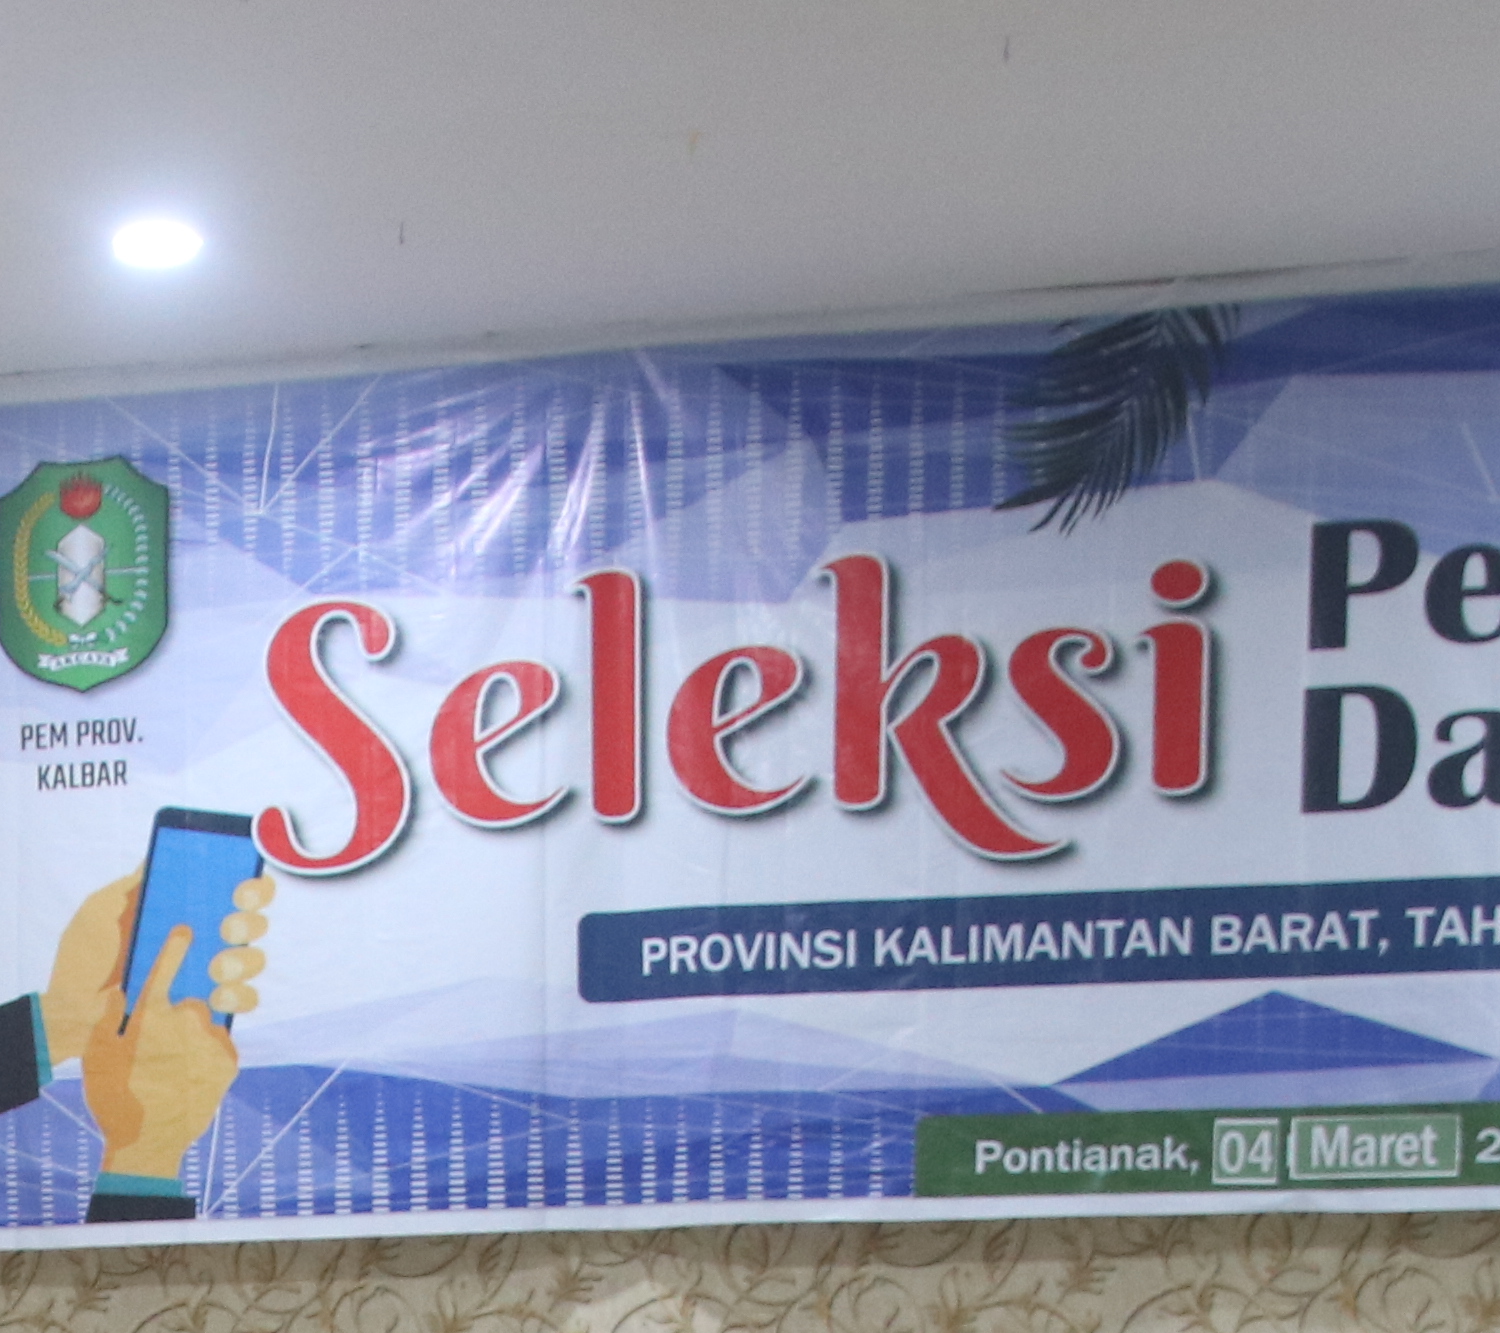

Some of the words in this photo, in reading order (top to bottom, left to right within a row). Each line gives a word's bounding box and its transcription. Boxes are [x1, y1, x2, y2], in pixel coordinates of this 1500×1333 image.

[20, 721, 68, 751] PEM
[76, 716, 144, 747] PROV.
[253, 553, 1214, 877] Seleksi
[37, 759, 128, 792] KALBAR
[641, 928, 859, 976] PROVINSI
[872, 916, 1192, 967] KALIMANTAN
[1210, 908, 1391, 959] BARAT,
[974, 1137, 1199, 1177] Pontianak,
[1218, 1132, 1275, 1175] 04
[1309, 1121, 1439, 1169] Maret
